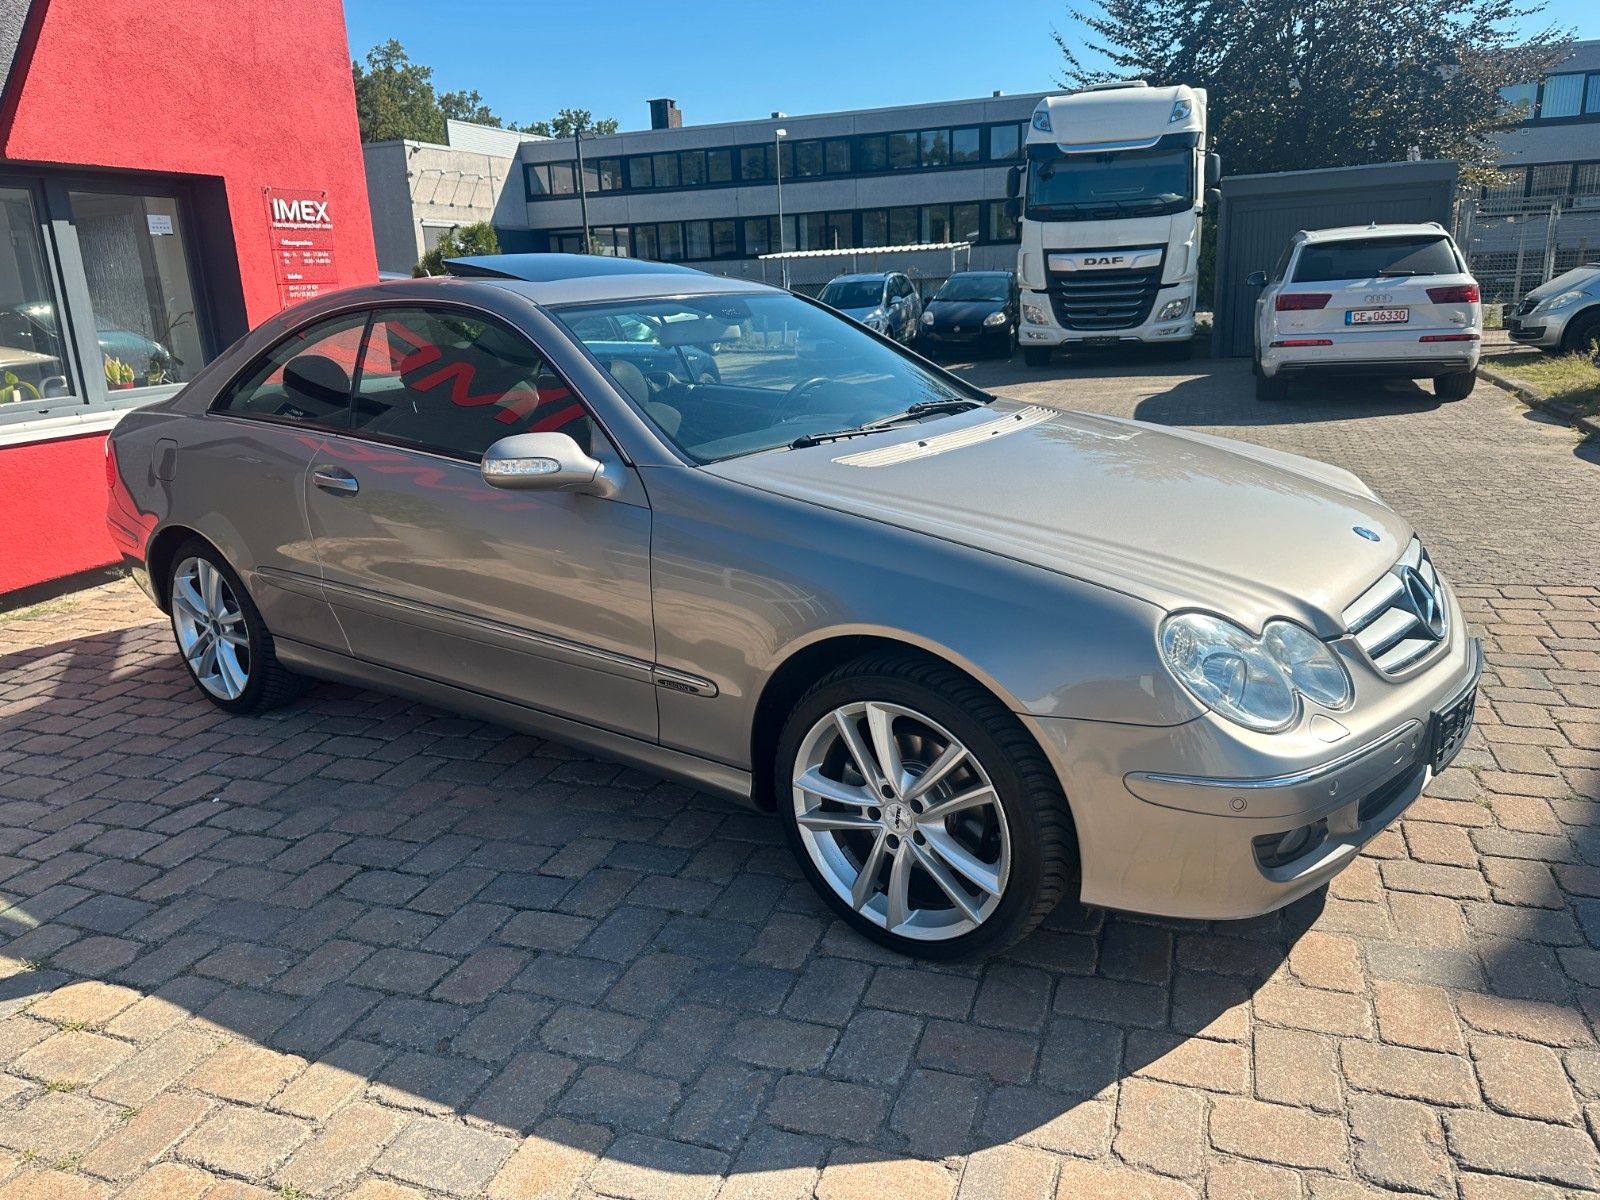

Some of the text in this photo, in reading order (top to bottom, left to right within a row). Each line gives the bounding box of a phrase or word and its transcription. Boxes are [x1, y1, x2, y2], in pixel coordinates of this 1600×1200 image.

[272, 198, 330, 222] IMEX
[1084, 256, 1124, 265] DAF
[1353, 309, 1405, 322] CE 06330
